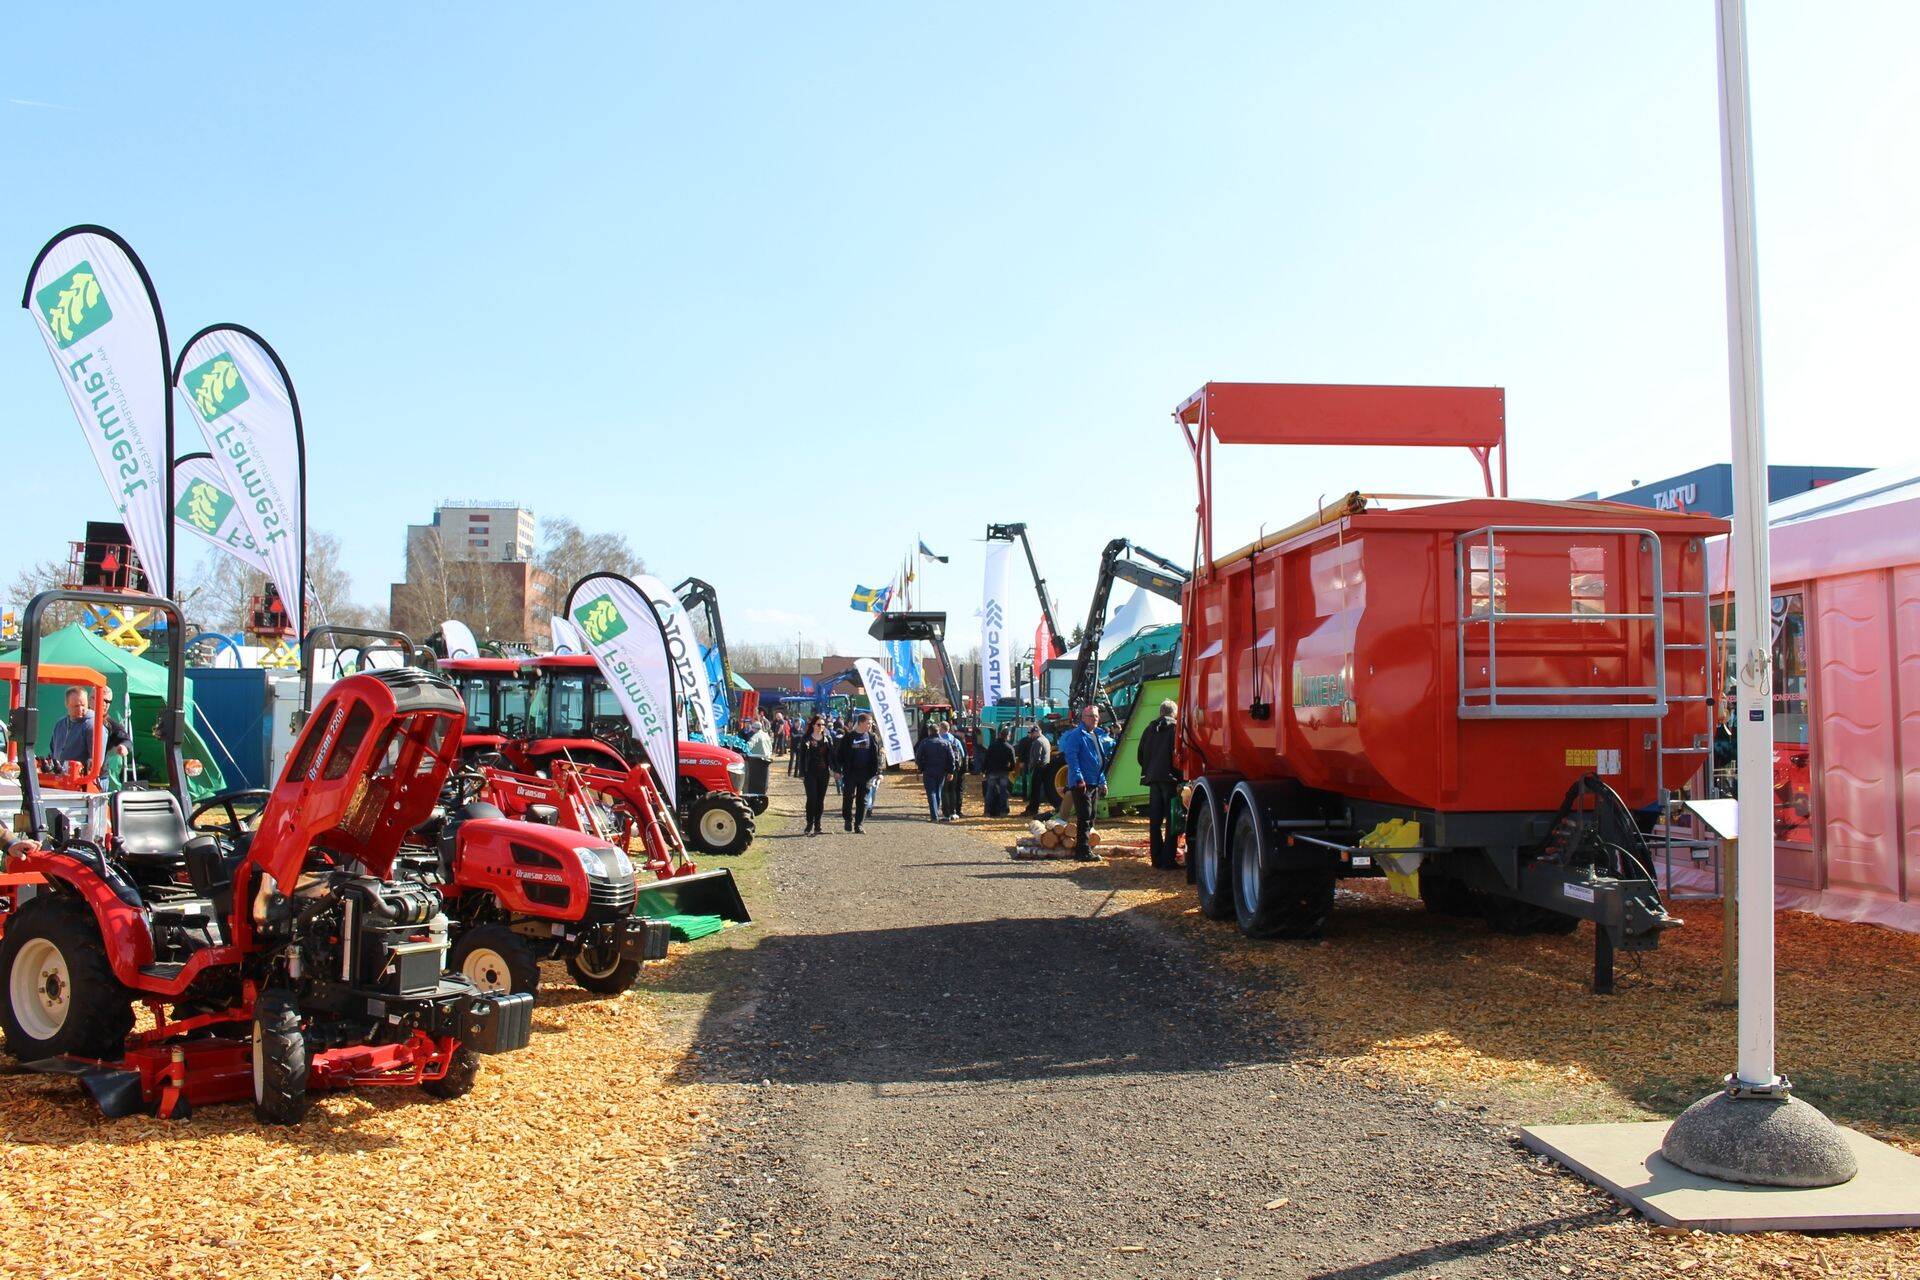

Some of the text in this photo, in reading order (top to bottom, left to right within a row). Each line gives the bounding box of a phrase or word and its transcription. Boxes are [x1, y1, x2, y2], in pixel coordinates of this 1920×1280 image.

[1653, 483, 1696, 511] TARTU
[308, 708, 344, 781] Branson 2200
[516, 785, 547, 799] Branson
[515, 869, 543, 880] Branson
